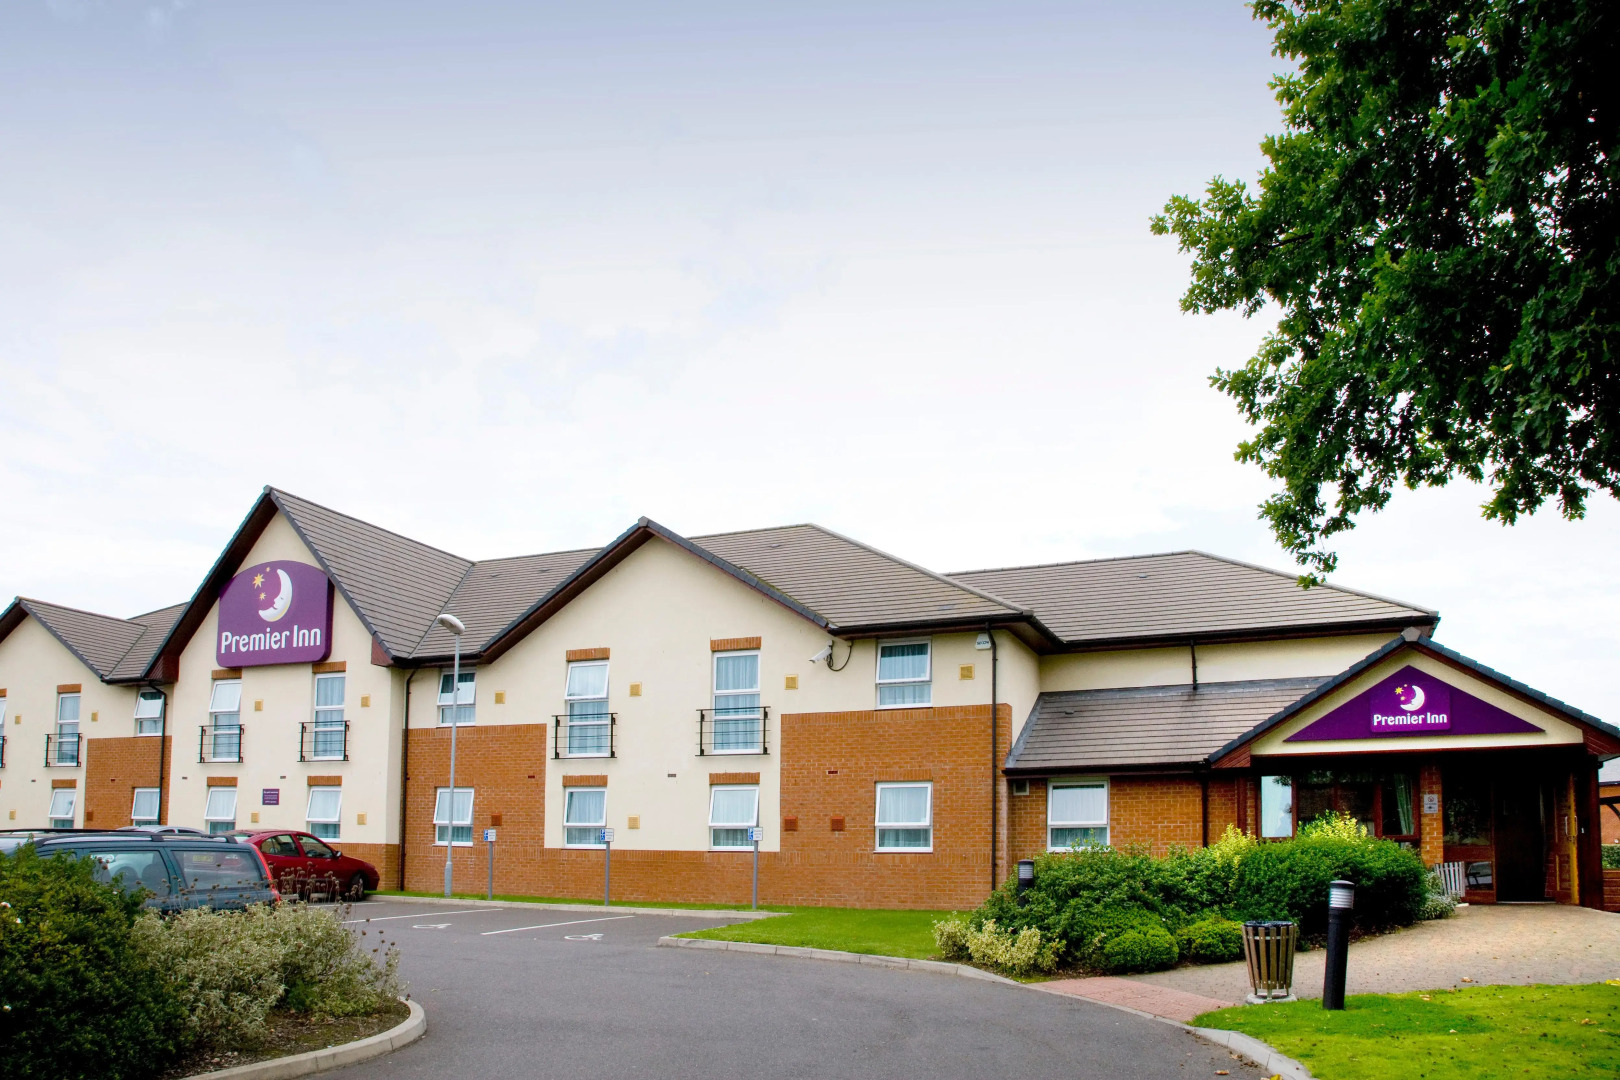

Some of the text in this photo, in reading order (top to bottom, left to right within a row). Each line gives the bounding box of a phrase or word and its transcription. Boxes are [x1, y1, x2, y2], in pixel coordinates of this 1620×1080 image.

[221, 625, 321, 653] Premier Inn
[1373, 712, 1448, 726] Premier Inn
